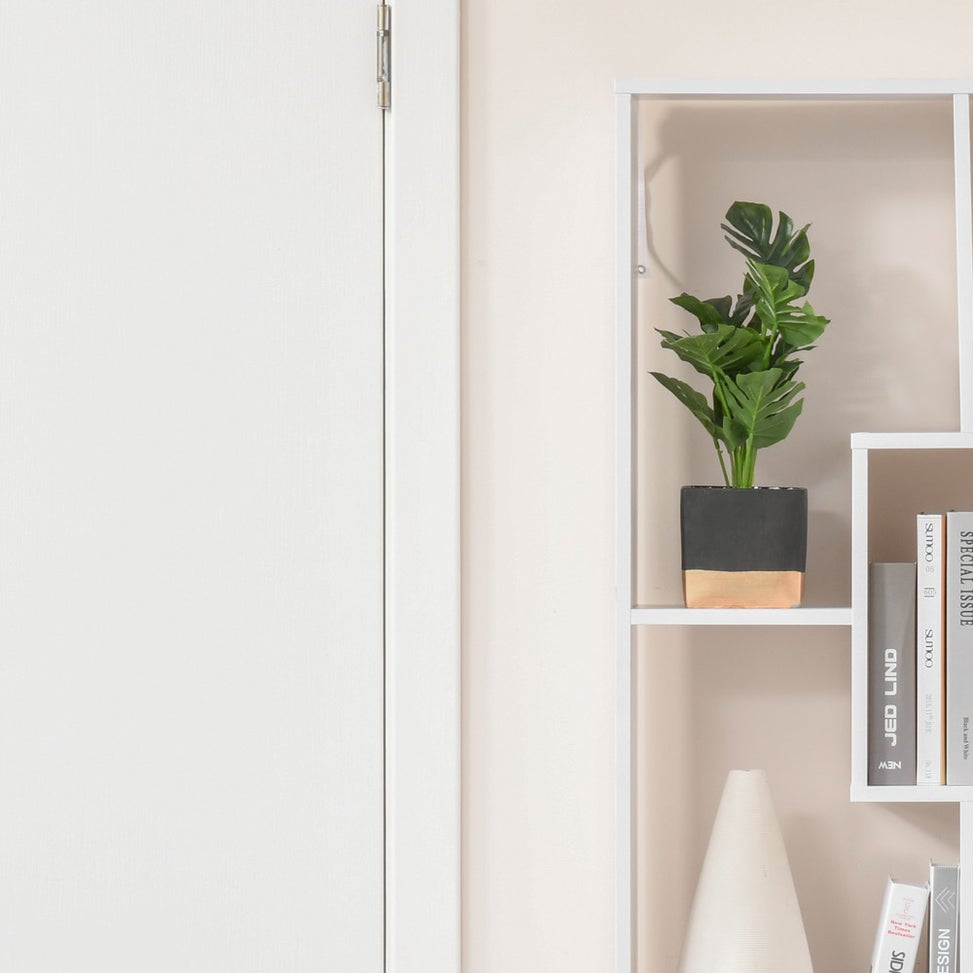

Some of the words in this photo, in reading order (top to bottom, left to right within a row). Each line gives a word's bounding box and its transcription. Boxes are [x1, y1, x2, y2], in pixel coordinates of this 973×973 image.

[960, 531, 973, 585] SPECIAL
[960, 590, 973, 627] ISSUE
[884, 648, 898, 696] LIND
[884, 704, 898, 747] JED
[878, 760, 902, 770] NEW
